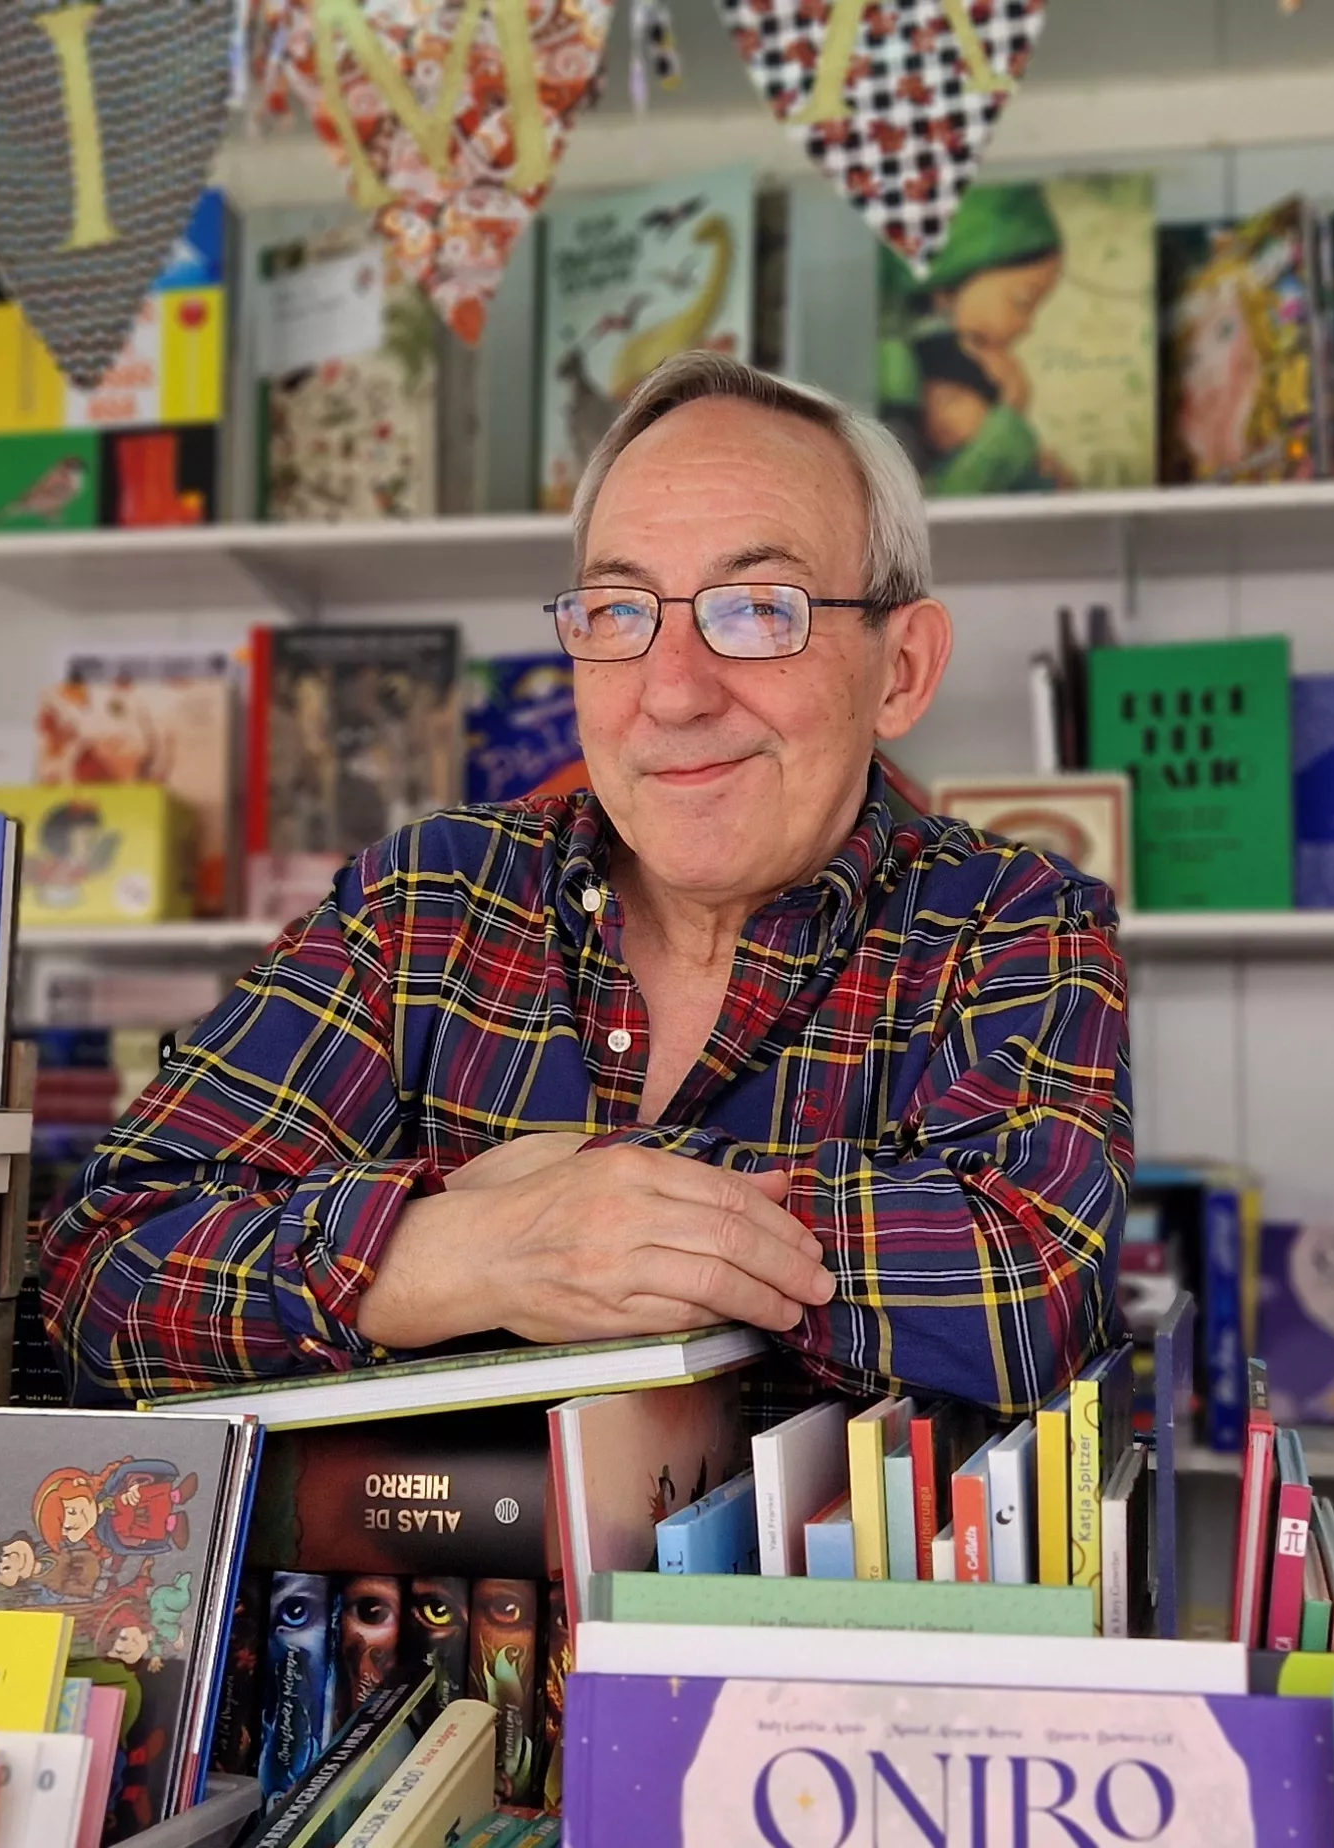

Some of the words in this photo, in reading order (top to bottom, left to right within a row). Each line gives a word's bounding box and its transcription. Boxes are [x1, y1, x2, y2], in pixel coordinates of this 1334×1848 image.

[1077, 1434, 1093, 1493] Spitzer
[364, 1474, 450, 1501] HIERRO
[364, 1508, 390, 1530] DE
[397, 1509, 461, 1534] ALAS
[1077, 1499, 1094, 1542] Katja
[753, 1747, 1175, 1848] ONIRO
